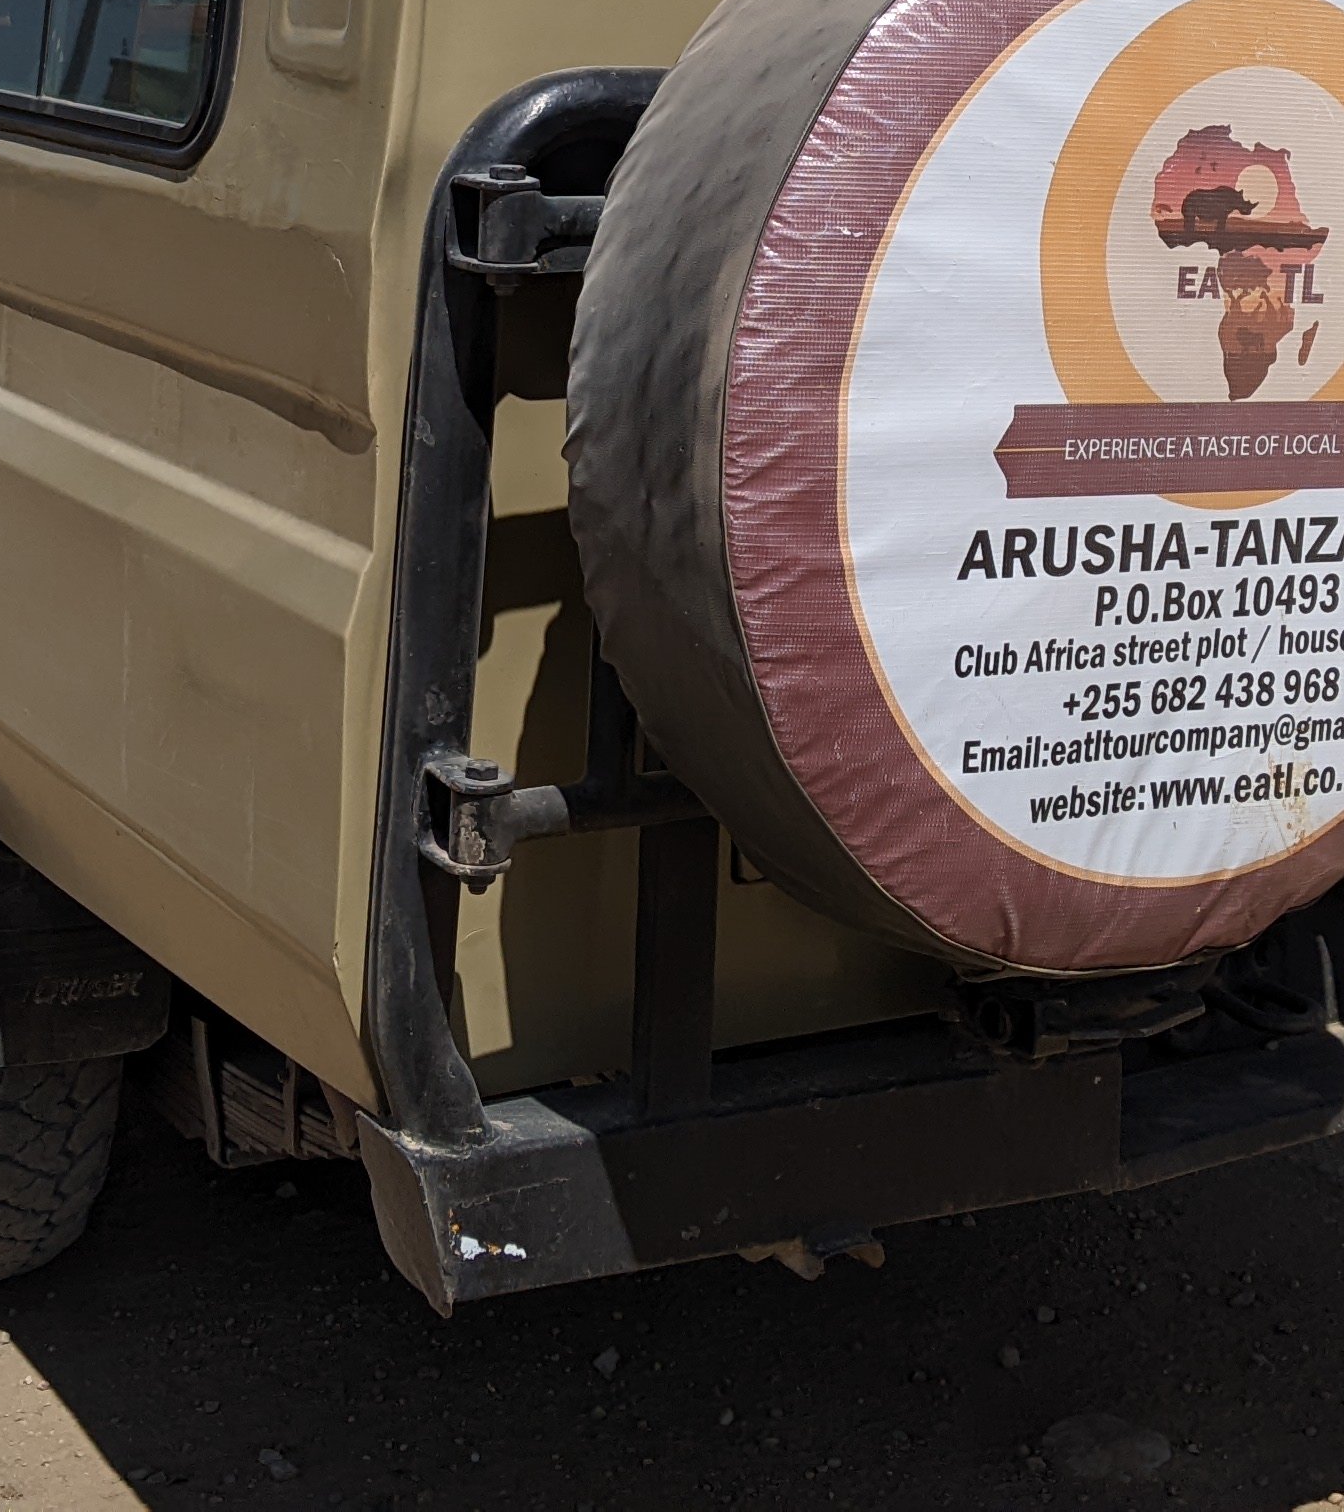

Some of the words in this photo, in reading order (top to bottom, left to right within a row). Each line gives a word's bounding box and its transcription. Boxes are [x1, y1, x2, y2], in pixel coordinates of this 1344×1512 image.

[1064, 437, 1177, 460] EXPERIENCE
[1180, 437, 1194, 458] A
[1197, 436, 1250, 457] TASTE
[1255, 435, 1280, 456] OF
[1283, 434, 1341, 455] LOCAL
[1094, 581, 1224, 627] P.O.Box
[1232, 573, 1341, 618] 10493
[954, 642, 1018, 678] Club
[1024, 638, 1106, 674] Africa
[1113, 629, 1191, 668] street
[1196, 626, 1248, 669] plot
[1251, 625, 1271, 663] /
[1062, 680, 1141, 722] +255
[1151, 674, 1206, 714] 682
[1215, 669, 1274, 709] 438
[1283, 666, 1340, 703] 968
